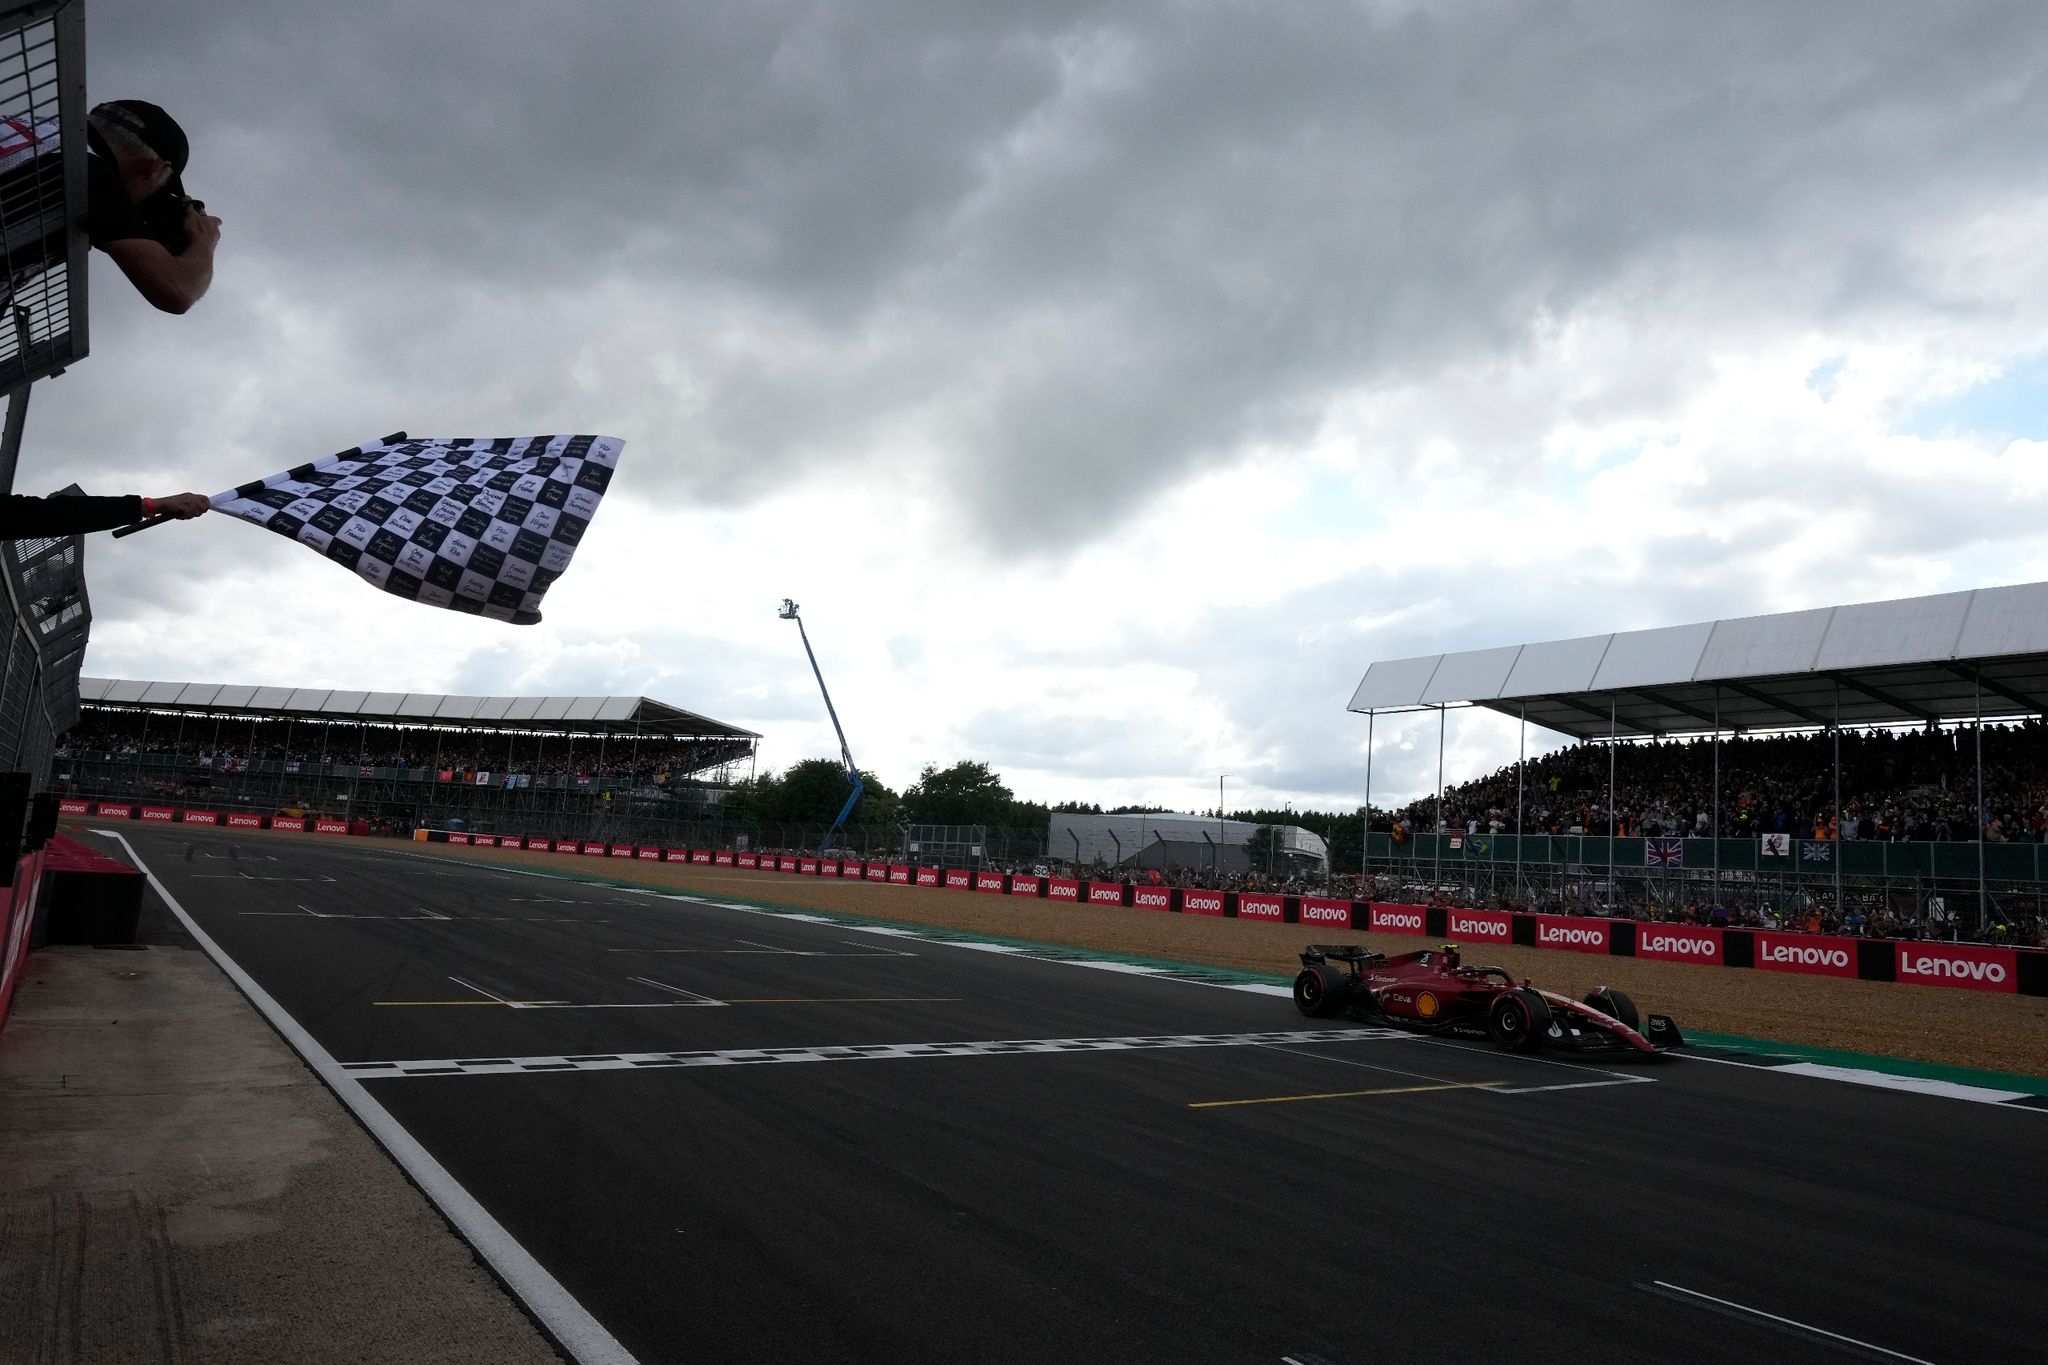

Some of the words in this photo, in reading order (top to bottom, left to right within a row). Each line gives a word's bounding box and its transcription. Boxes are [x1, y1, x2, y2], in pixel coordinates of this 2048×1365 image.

[59, 804, 86, 813] enovo
[99, 806, 128, 817] Lenovo
[143, 810, 172, 820] Lenovo
[185, 813, 215, 823] Lenovo
[229, 816, 259, 826] Lenovo
[273, 819, 302, 829] Lenovo
[316, 822, 346, 833] Lenovo
[449, 834, 468, 843] Lenovo
[474, 837, 494, 846] Lenovo
[501, 839, 520, 848] Lenovo
[528, 841, 548, 850] Lenovo
[556, 843, 577, 852] Lenovo
[584, 845, 604, 854] Lenovo
[611, 847, 632, 856] Lenovo
[639, 850, 659, 859] Lenovo
[889, 869, 908, 881] Lenovo
[1035, 867, 1047, 875] SC
[916, 871, 936, 884] Lenovo
[946, 873, 968, 887] Lenovo
[977, 876, 1002, 890] Lenovo
[1012, 879, 1037, 893] Lenovo
[1049, 883, 1077, 897] Lenovo
[1090, 887, 1120, 901] Lenovo
[1135, 891, 1166, 905] Lenovo
[1185, 895, 1220, 910] Lenovo
[1241, 900, 1279, 915] Lenovo
[1303, 904, 1346, 921] Lenovo
[1372, 910, 1421, 928] Lenovo
[1451, 916, 1506, 935] Lenovo
[1539, 924, 1603, 945] Lenovo
[1642, 932, 1715, 955] Lenovo
[1761, 941, 1848, 967] Lenovo
[1901, 952, 2005, 982] Lenovo
